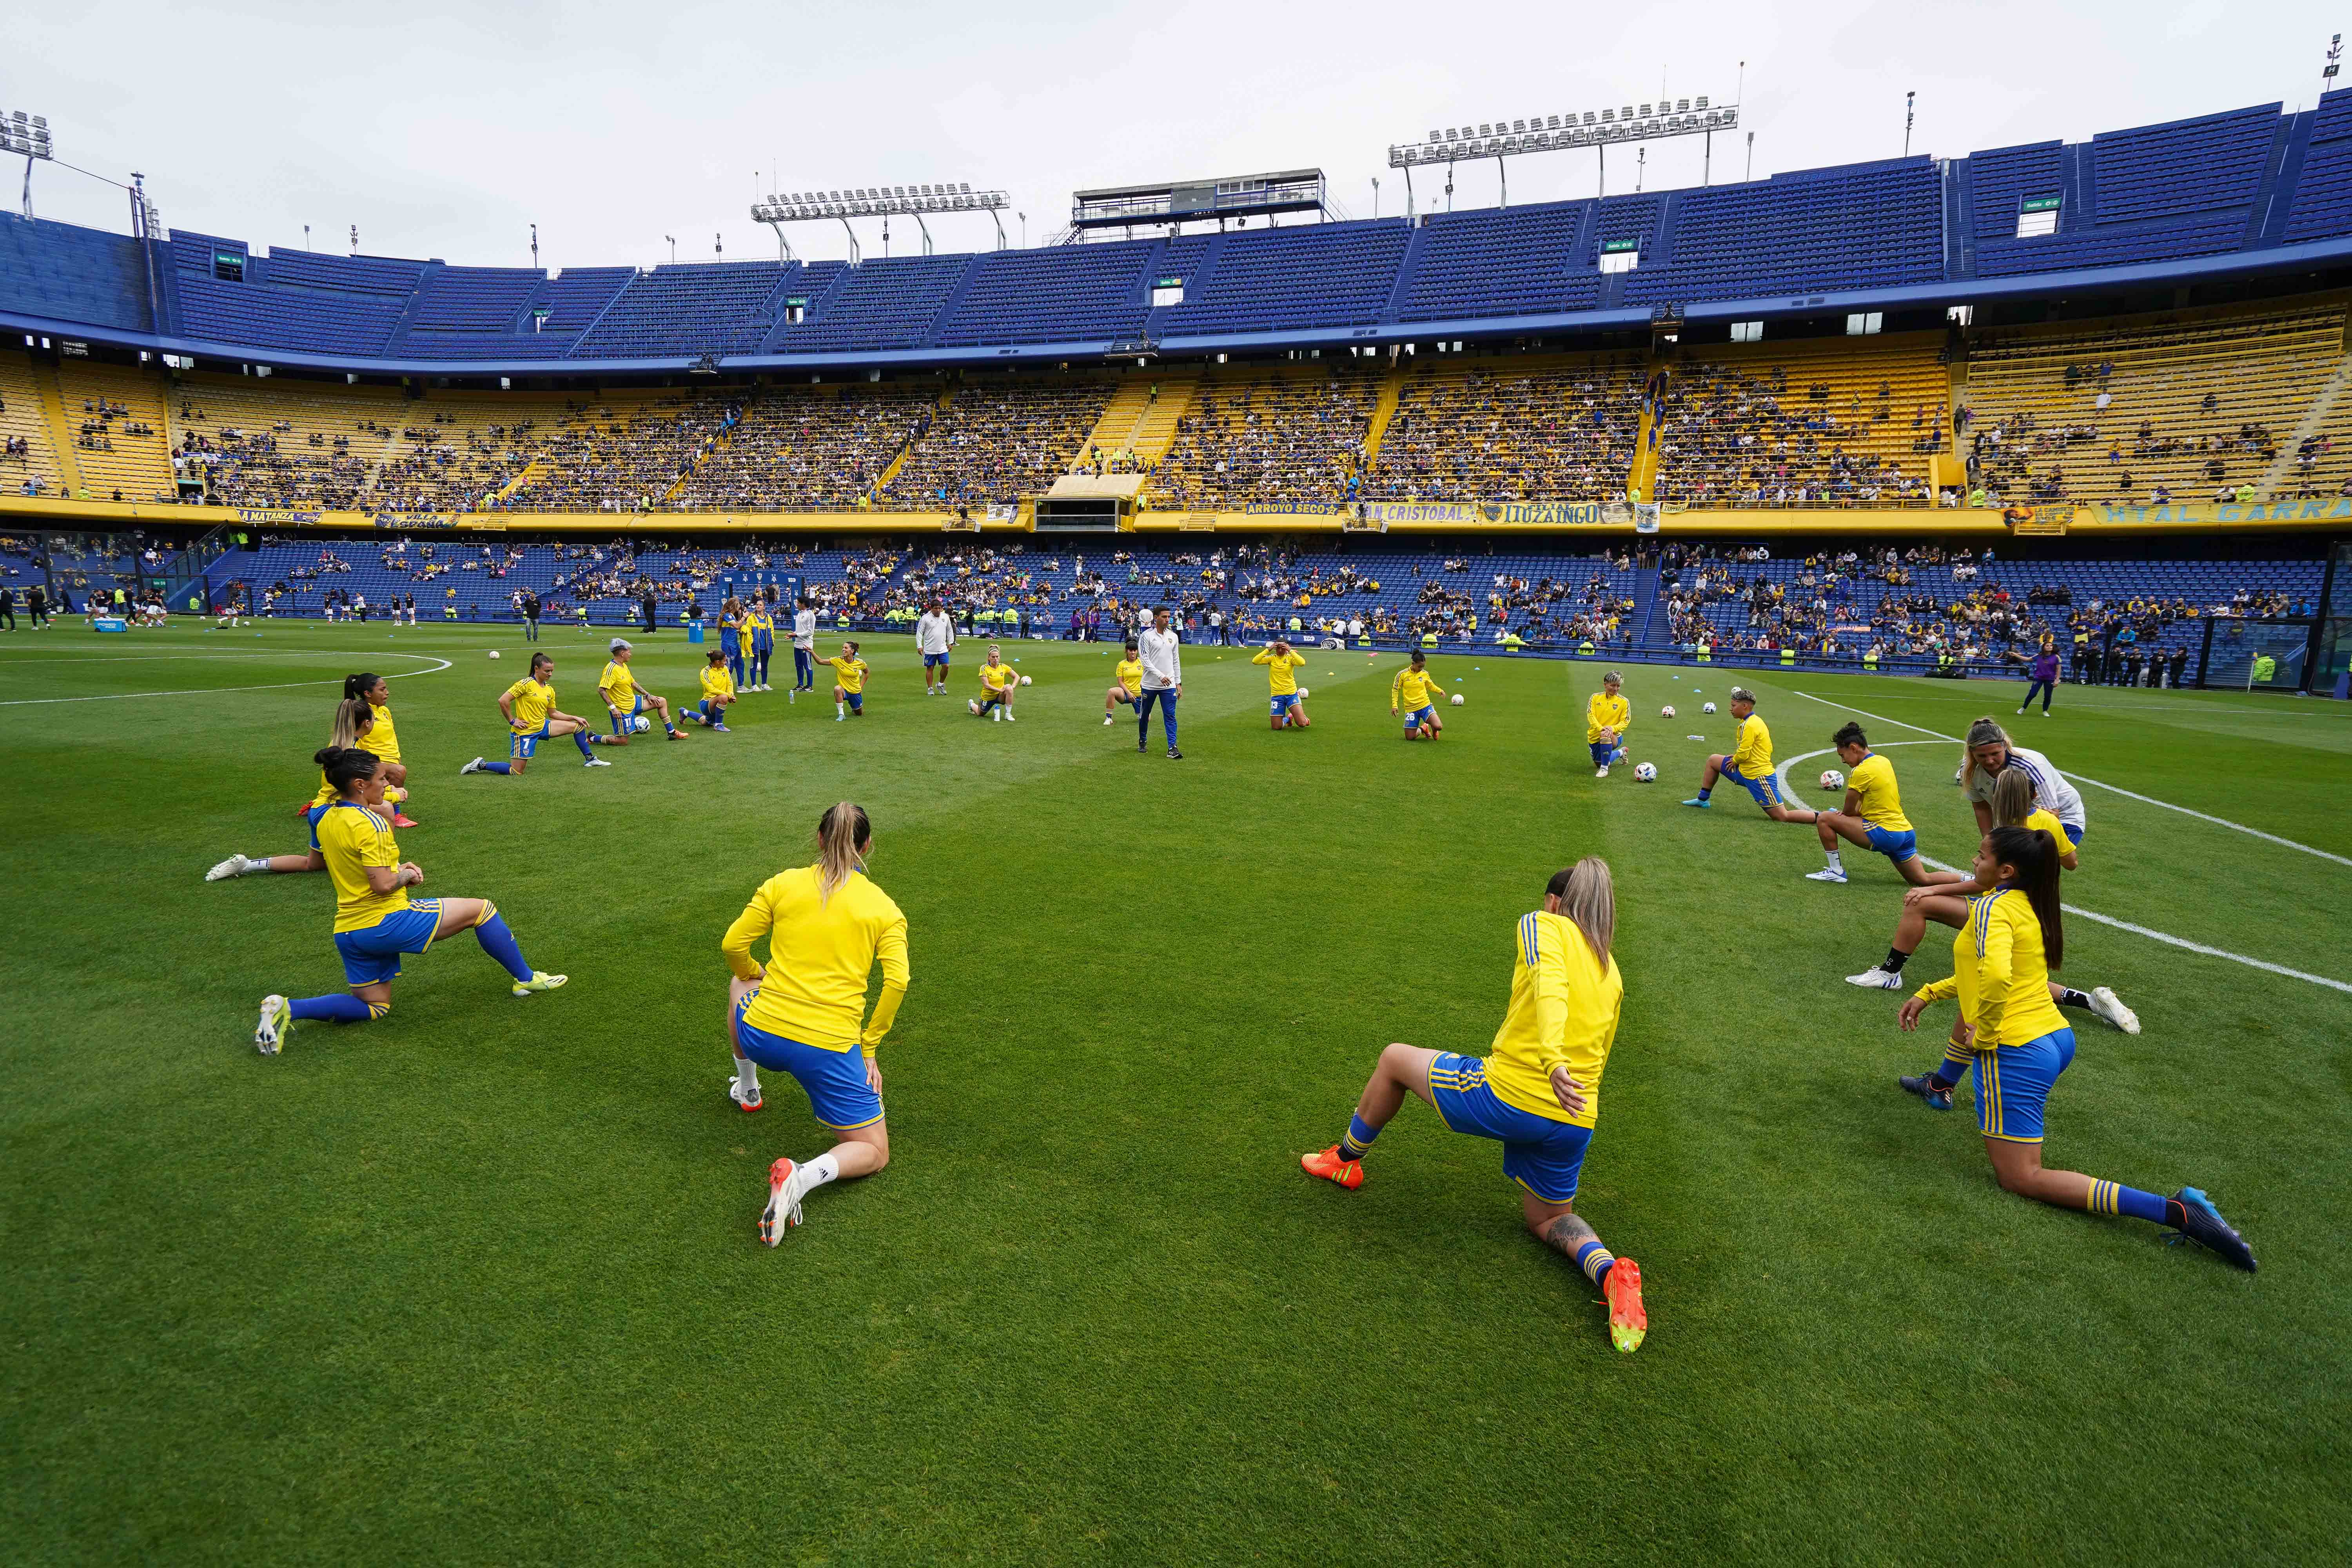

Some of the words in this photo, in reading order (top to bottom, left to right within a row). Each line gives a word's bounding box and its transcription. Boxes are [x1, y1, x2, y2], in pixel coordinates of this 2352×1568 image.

[1248, 504, 1293, 514] ARROYO
[1295, 504, 1325, 514] SECO
[1387, 505, 1464, 521] CRISTOBAL
[1504, 504, 1598, 524] ITUZAINGO
[2106, 506, 2198, 522] HTAL
[250, 511, 295, 521] MATANZA
[1271, 701, 1278, 709] 13
[1405, 712, 1415, 721] 26
[624, 717, 631, 727] 11
[523, 738, 530, 749] 7
